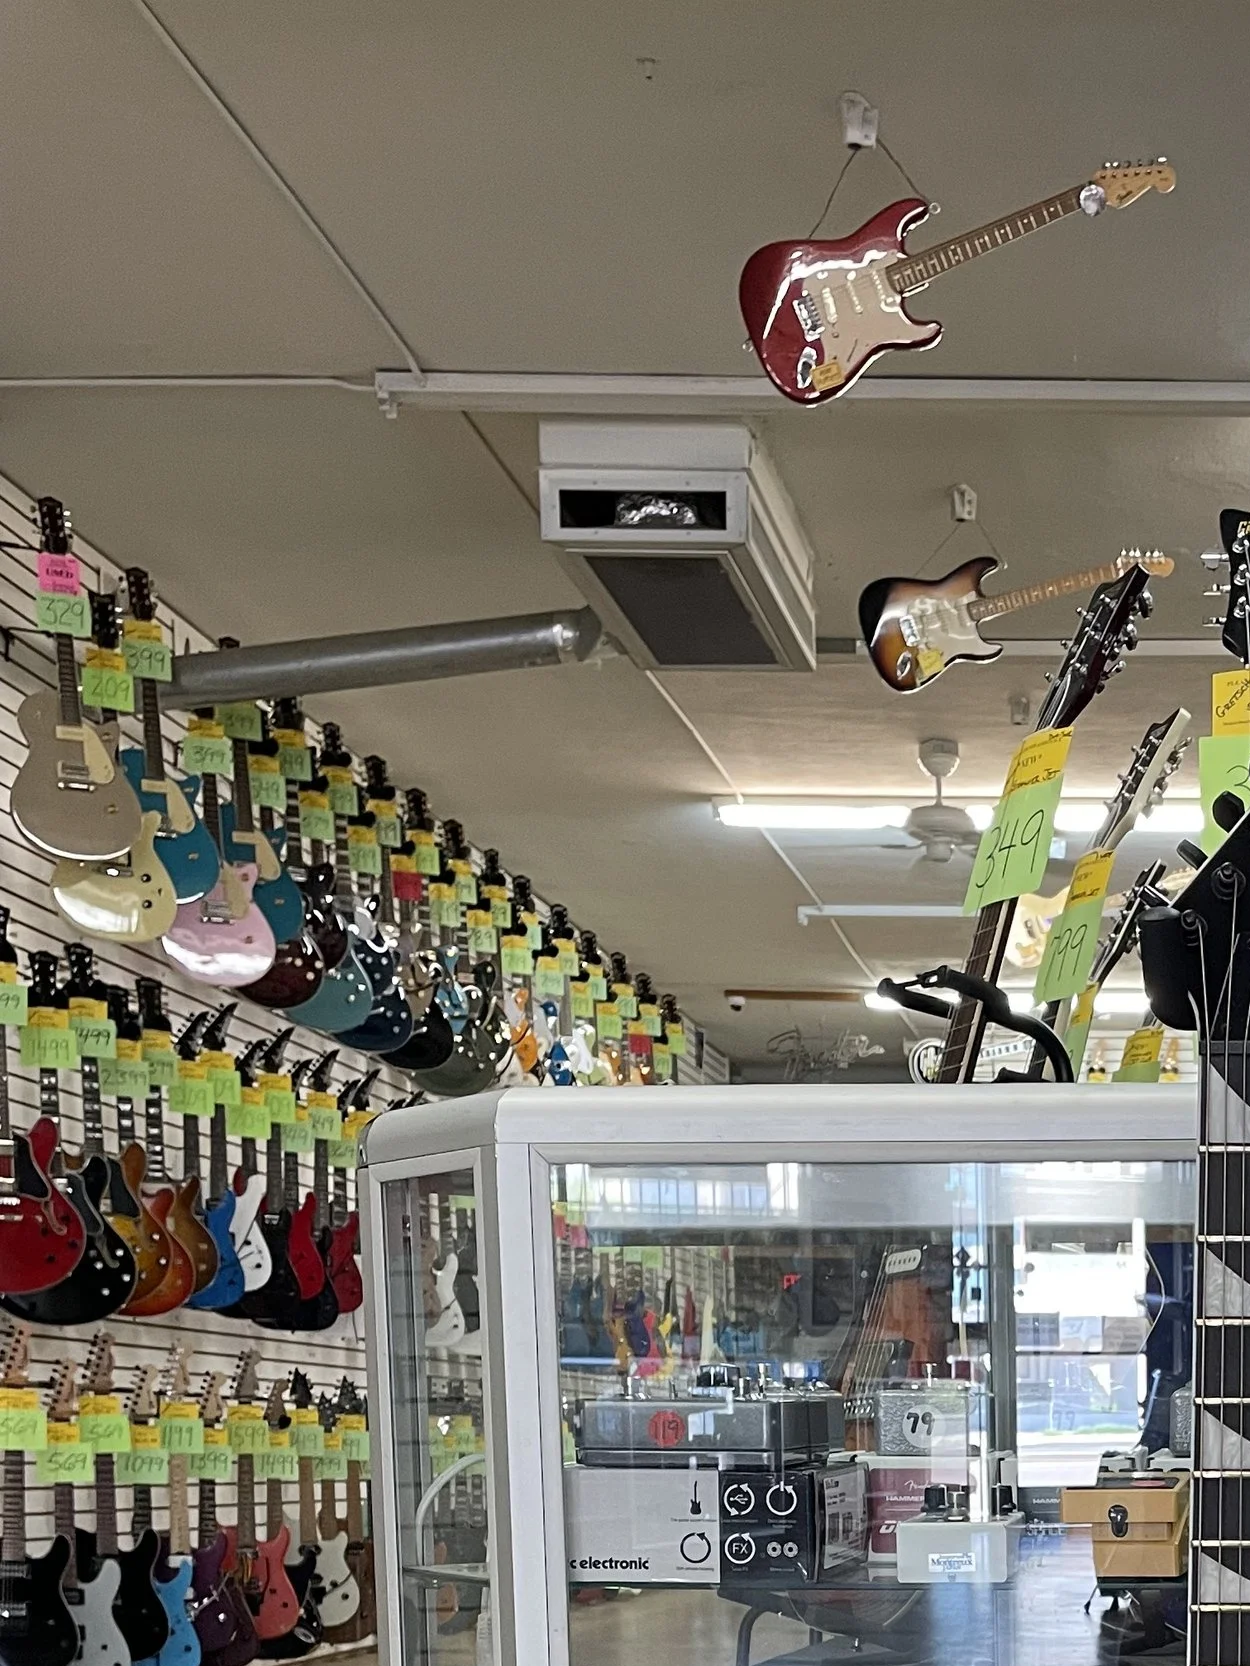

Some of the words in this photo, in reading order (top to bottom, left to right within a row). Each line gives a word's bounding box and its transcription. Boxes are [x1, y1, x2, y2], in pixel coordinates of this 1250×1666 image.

[43, 597, 84, 629] 329
[126, 644, 165, 673] 399
[975, 809, 1045, 889] 349
[1044, 923, 1088, 988] 799
[907, 1412, 935, 1436] 79
[47, 1451, 87, 1472] 569
[123, 1455, 164, 1473] 1099
[733, 1542, 749, 1555] FX
[580, 1557, 650, 1571] electronic
